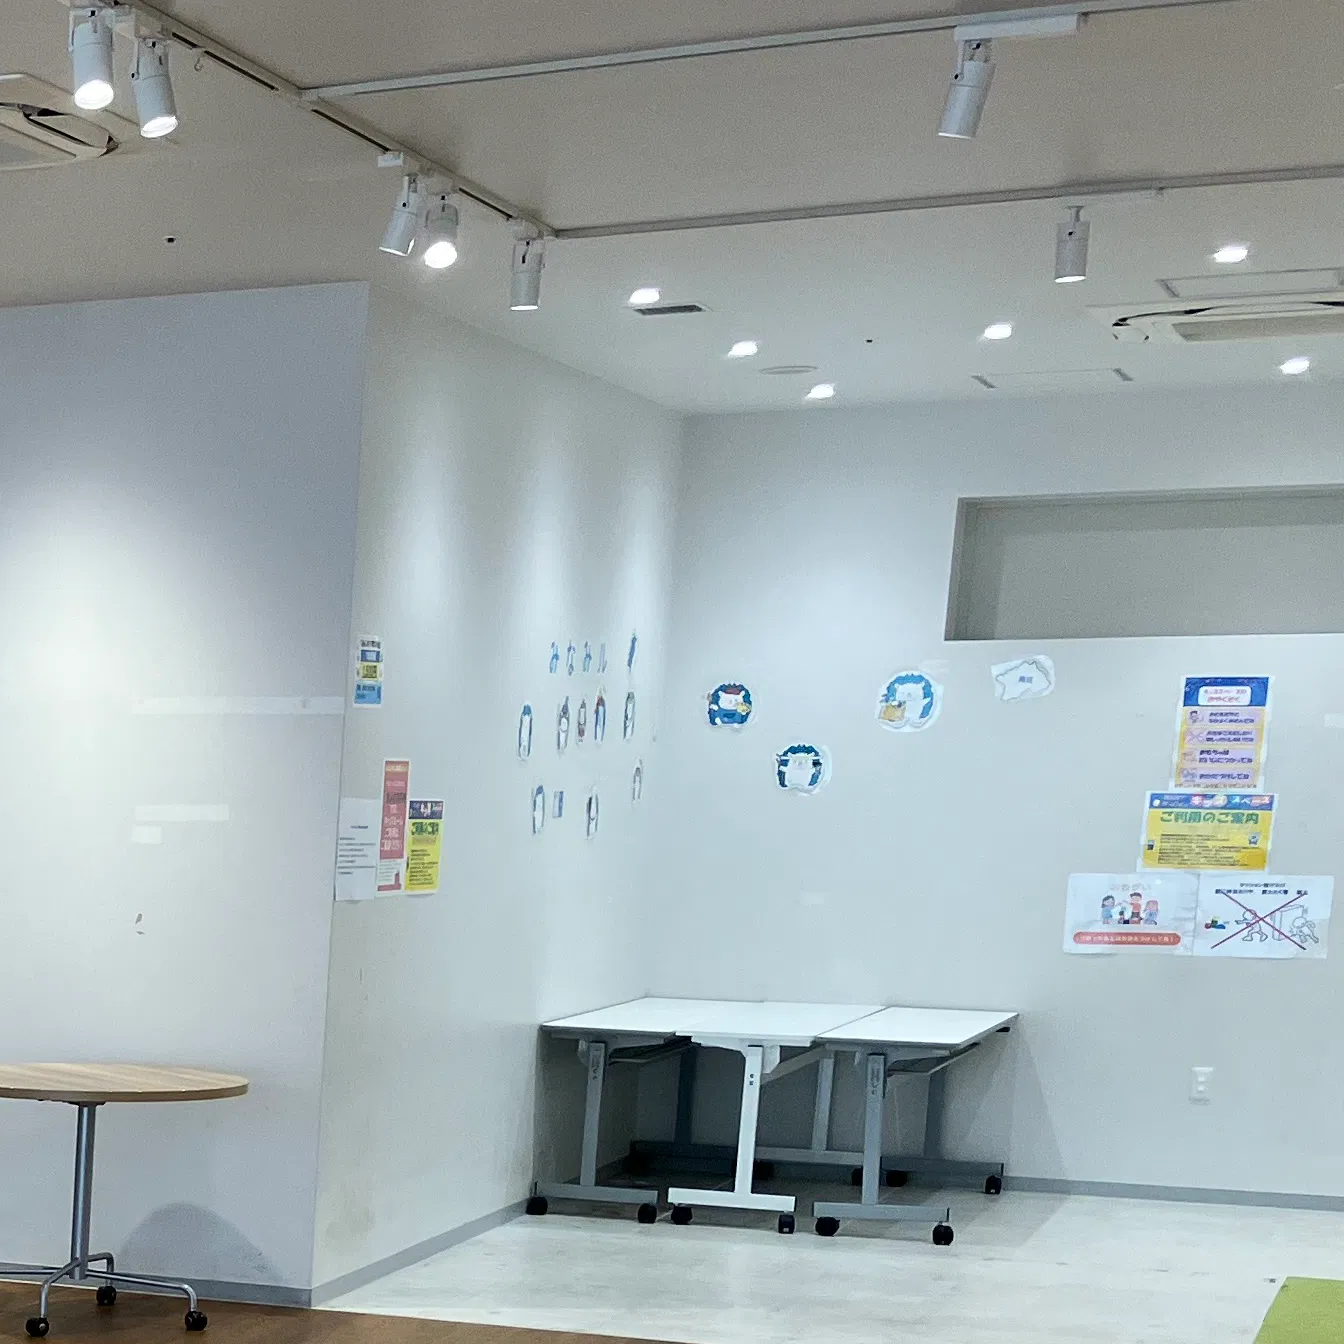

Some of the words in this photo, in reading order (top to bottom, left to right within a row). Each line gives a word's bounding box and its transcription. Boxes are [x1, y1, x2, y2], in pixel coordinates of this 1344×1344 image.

[1160, 811, 1260, 825] ご利用のご案内
